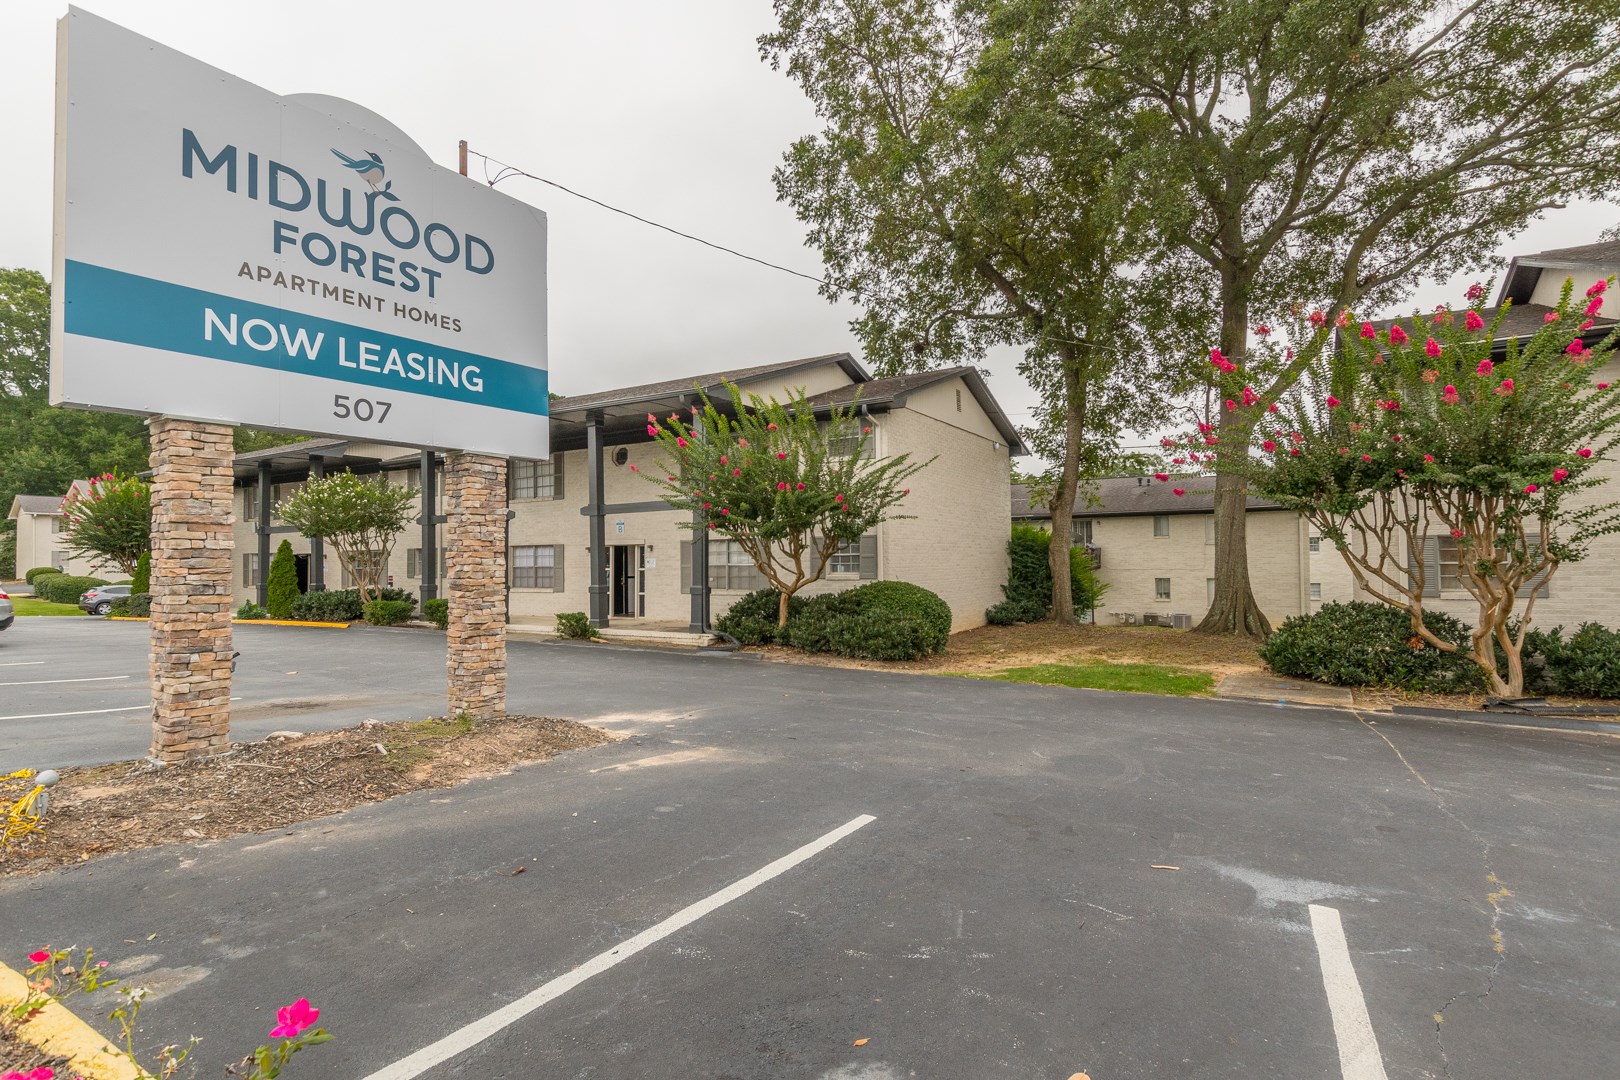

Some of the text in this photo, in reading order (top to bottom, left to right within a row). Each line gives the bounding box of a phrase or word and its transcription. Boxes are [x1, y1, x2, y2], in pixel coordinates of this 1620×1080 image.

[182, 127, 495, 275] MIDWOOD
[237, 261, 462, 333] APARTMENT HOMES
[273, 219, 442, 298] FOREST
[204, 308, 484, 393] NOW LEASING
[332, 394, 392, 424] 507
